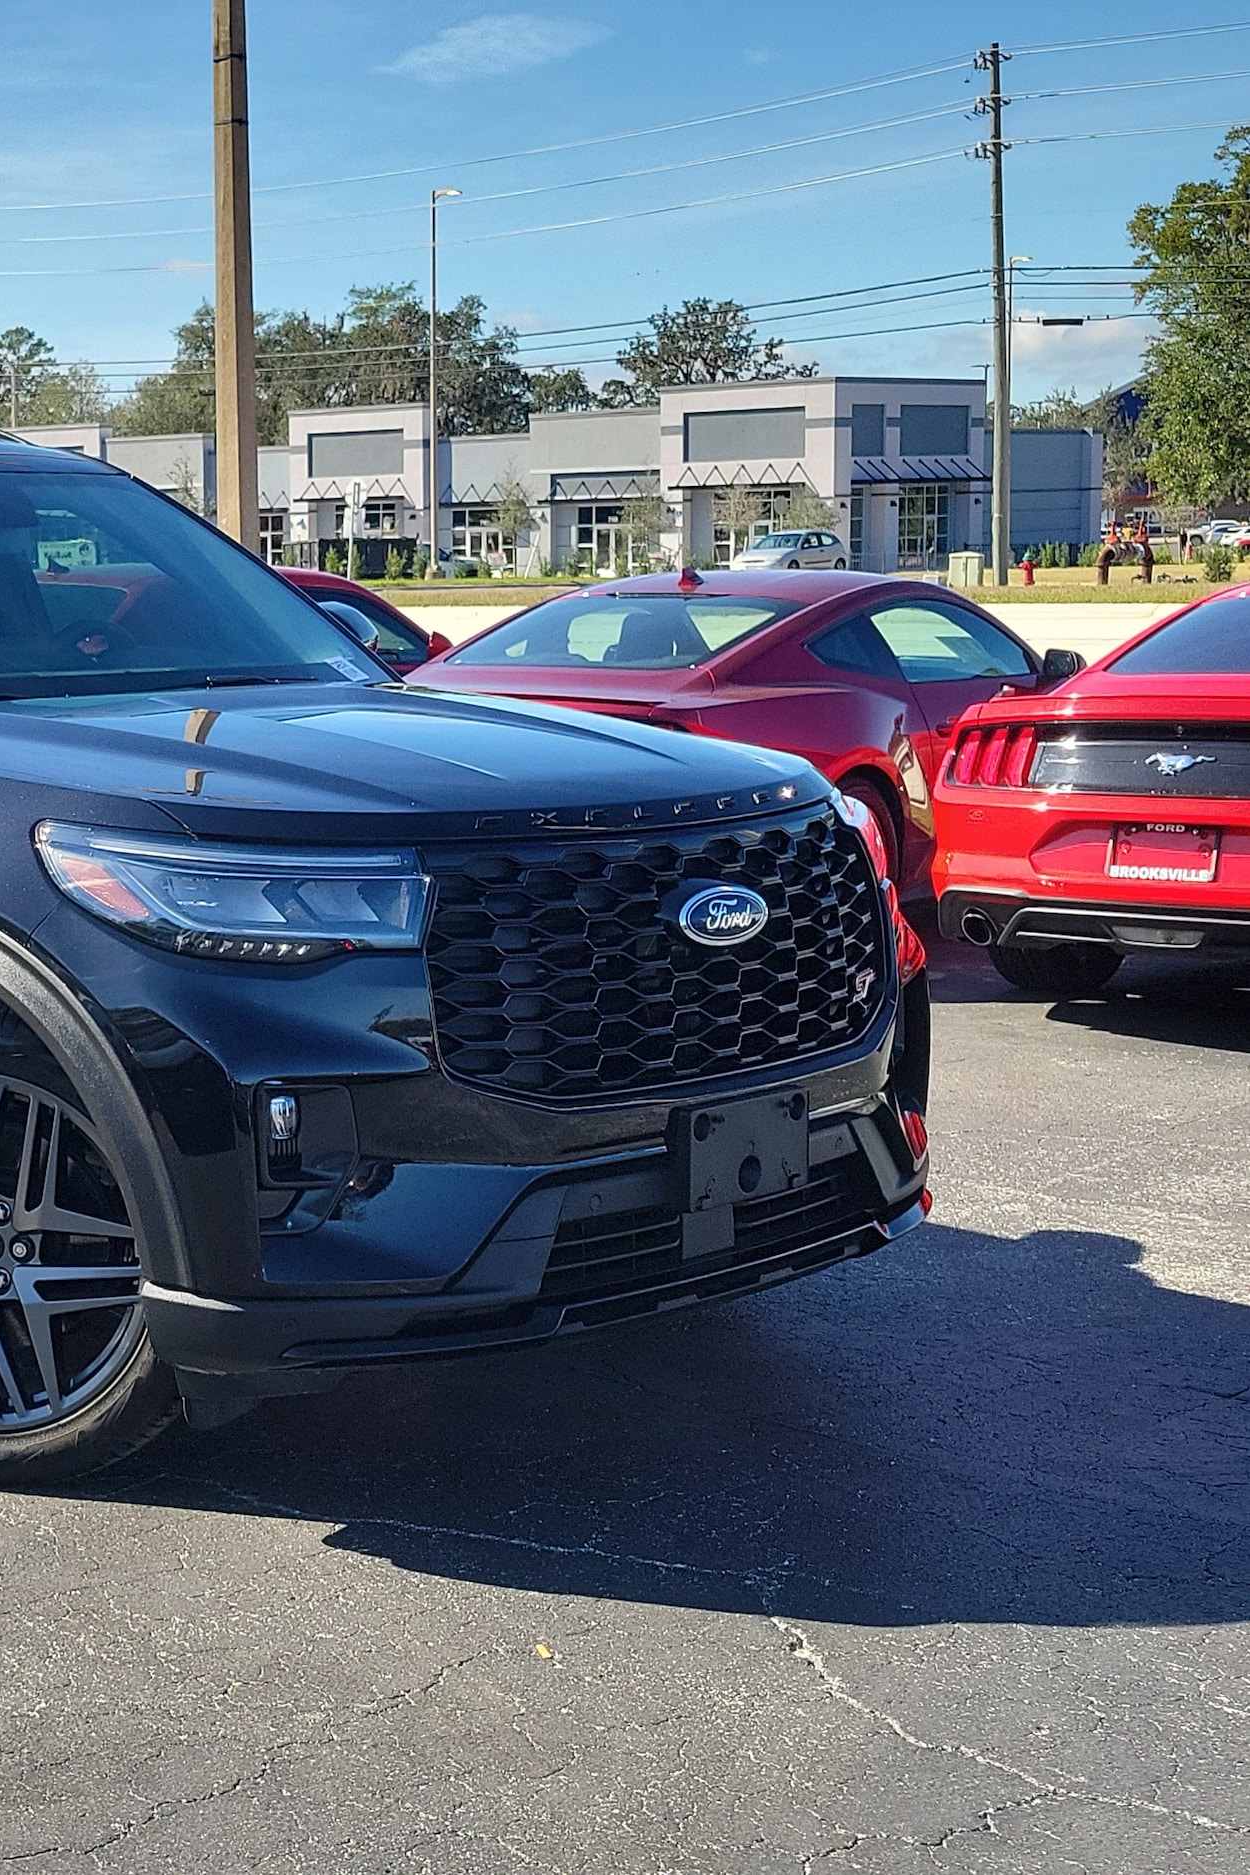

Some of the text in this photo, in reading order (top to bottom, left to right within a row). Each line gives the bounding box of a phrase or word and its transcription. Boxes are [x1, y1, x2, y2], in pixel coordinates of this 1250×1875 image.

[1146, 823, 1186, 832] FORD
[1109, 865, 1211, 881] BROOKSVILLE
[707, 899, 753, 929] Ford
[853, 967, 876, 1002] ST
